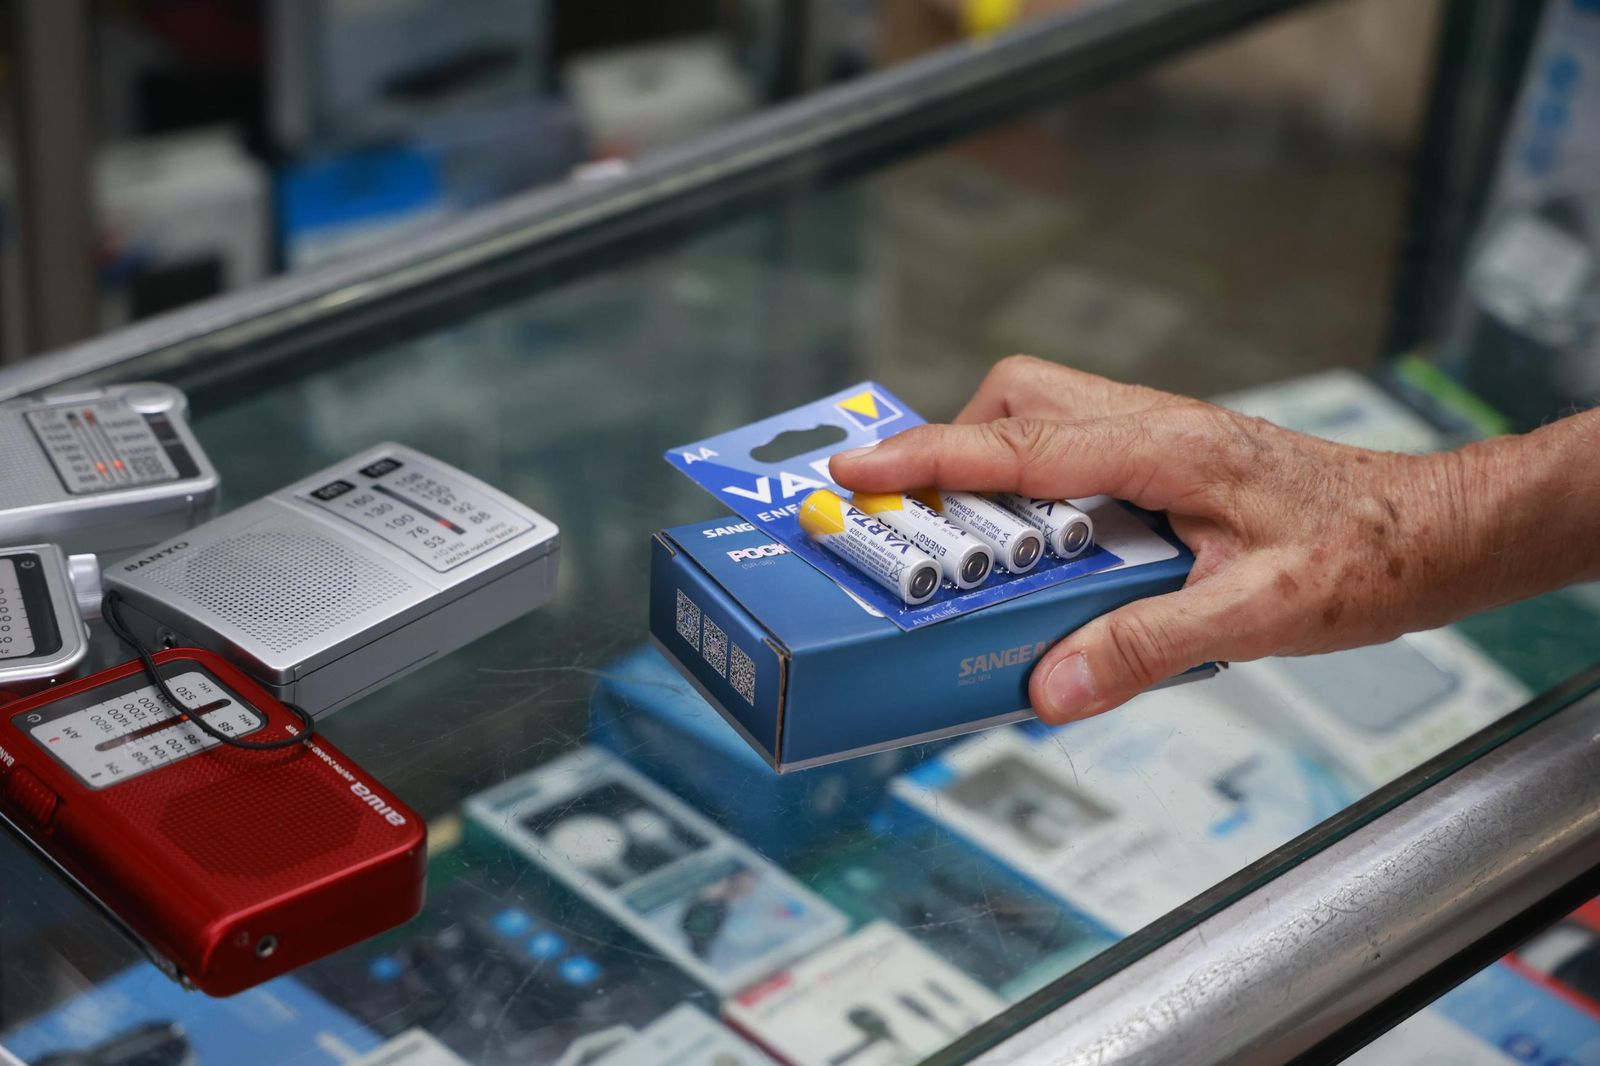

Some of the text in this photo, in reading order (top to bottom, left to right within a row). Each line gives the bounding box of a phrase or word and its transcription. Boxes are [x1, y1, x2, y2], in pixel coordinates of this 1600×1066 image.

[682, 446, 719, 465] AA
[944, 495, 976, 518] GERMANY
[385, 514, 415, 530] 100
[469, 512, 491, 525] 88
[407, 526, 430, 539] 76
[702, 522, 756, 539] SANG
[847, 506, 911, 555] VARTA
[848, 527, 868, 542] 12.2029
[983, 519, 1002, 535] MADE
[424, 536, 446, 549] 53
[913, 531, 947, 557] ENERGY
[123, 541, 190, 573] SANYO
[911, 606, 962, 626] ALKALINE
[958, 640, 1050, 677] SANGEA
[176, 686, 197, 701] 530
[123, 703, 147, 721] 1200
[138, 697, 164, 716] 1000
[90, 715, 114, 734] 1600
[107, 708, 131, 727] 1400
[62, 726, 82, 739] AM
[218, 721, 234, 732] 88
[166, 738, 186, 753] 100
[184, 734, 200, 745] 96
[131, 751, 152, 766] 108
[149, 745, 168, 759] 104
[105, 762, 123, 775] FM
[350, 781, 406, 826] aiwa
